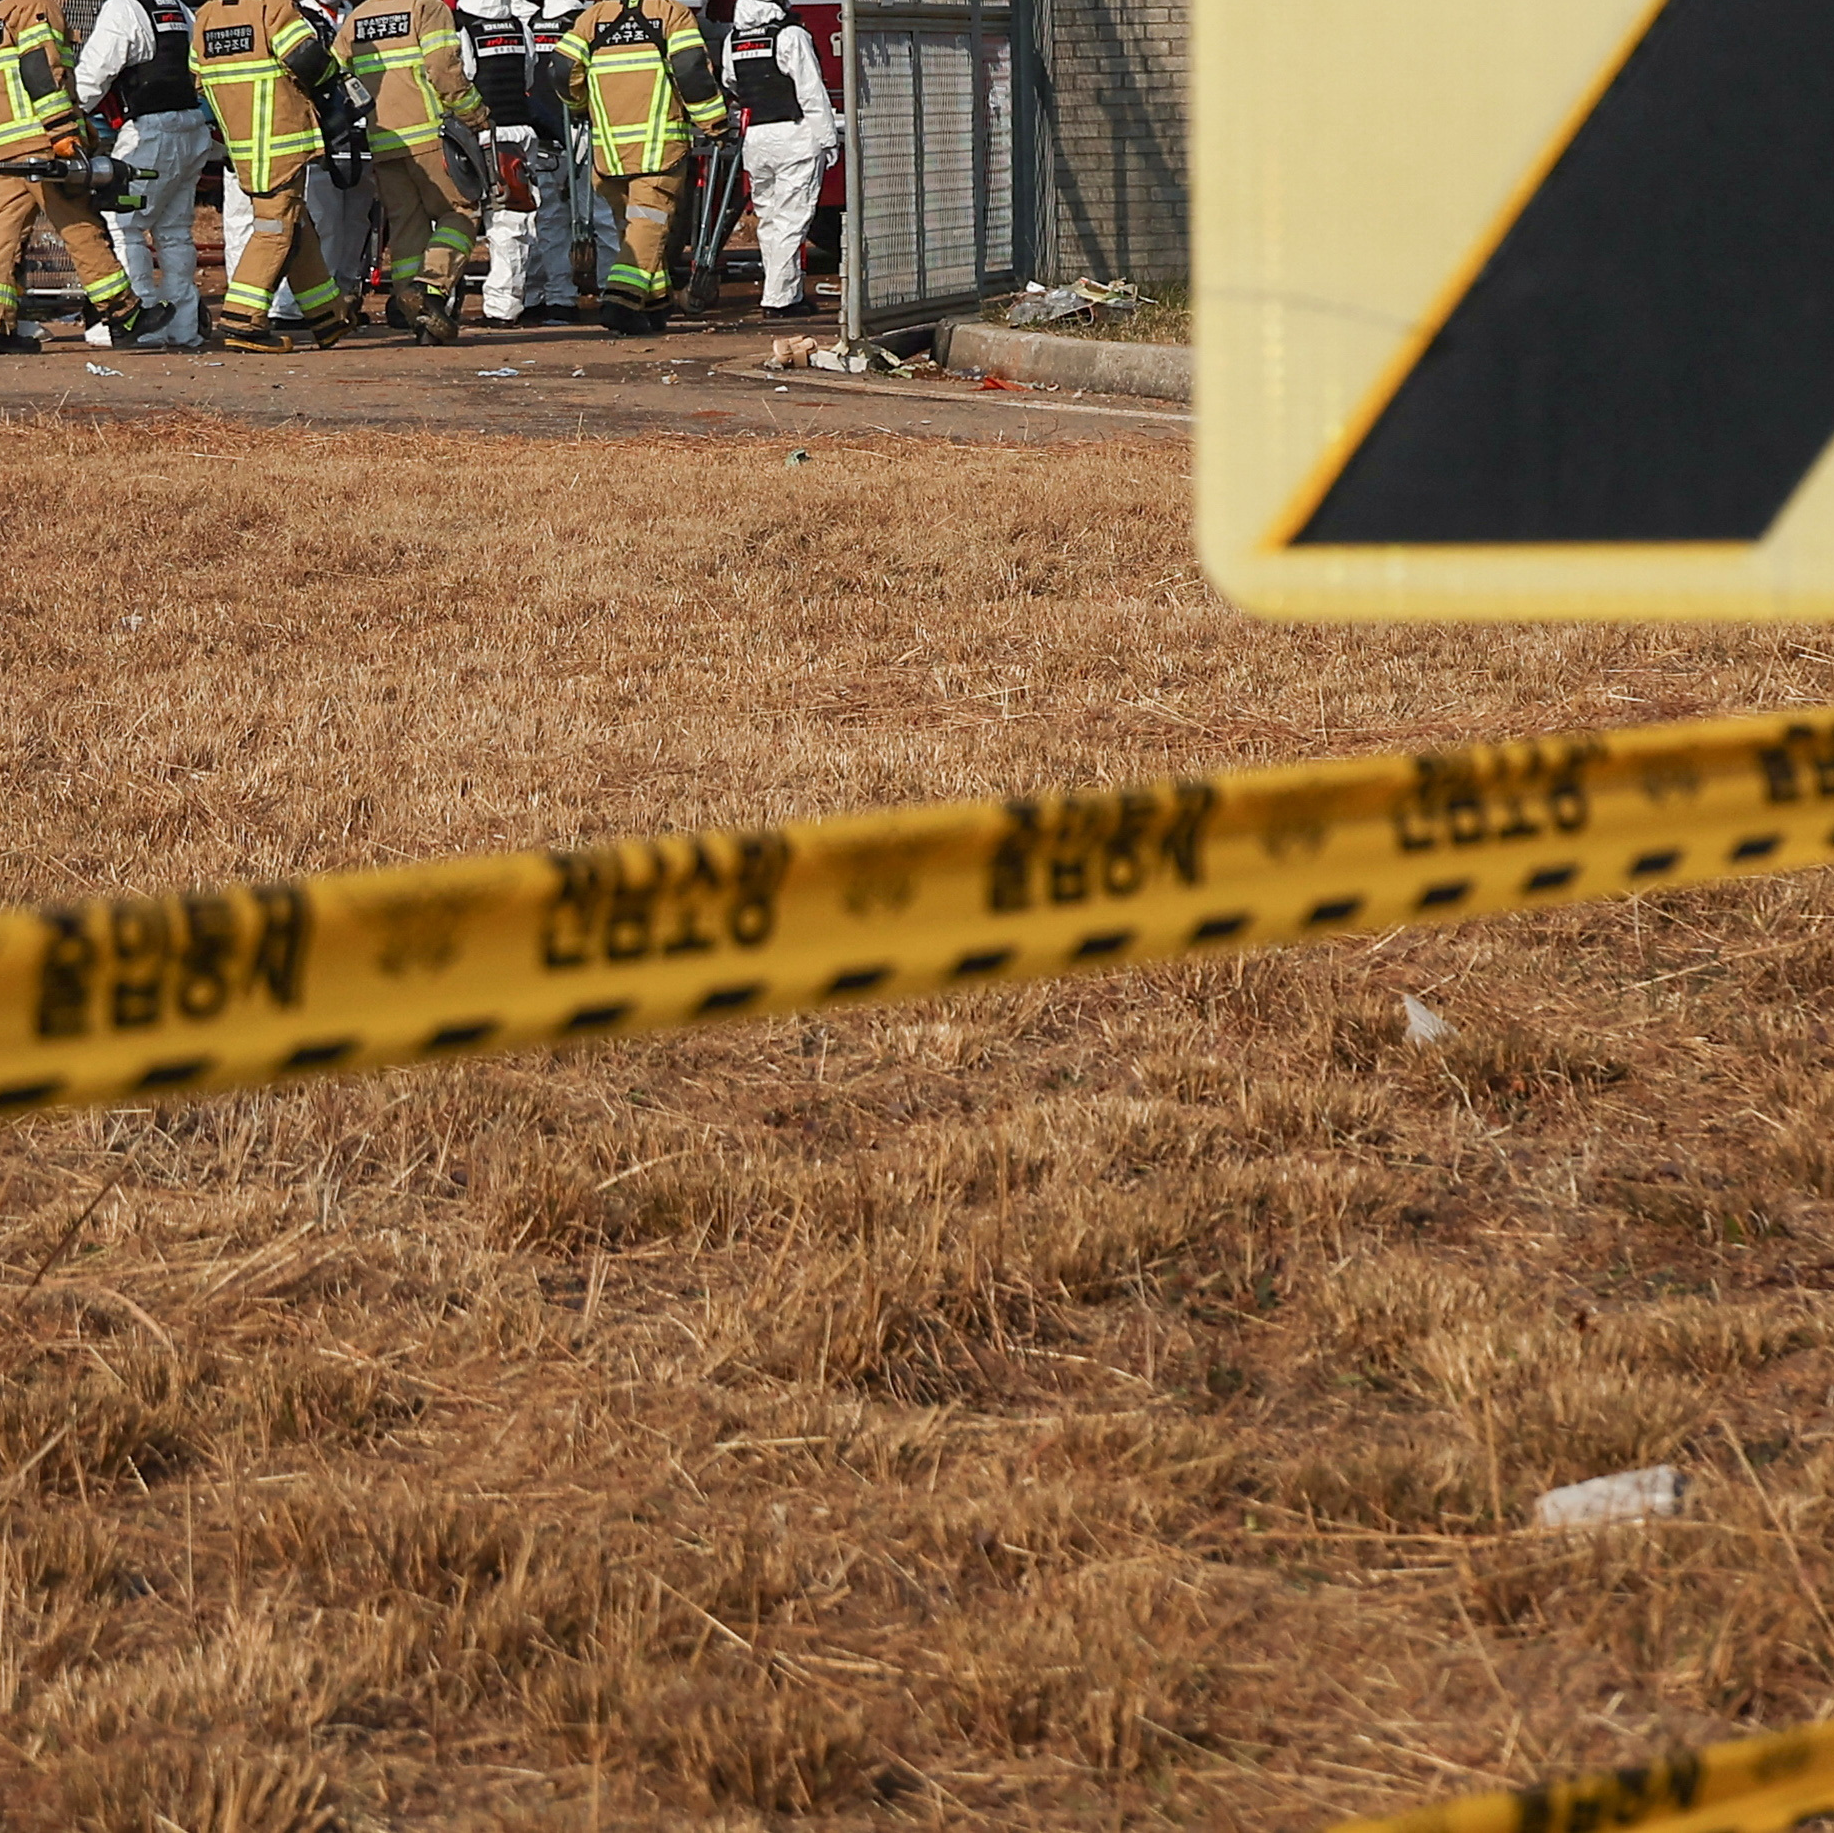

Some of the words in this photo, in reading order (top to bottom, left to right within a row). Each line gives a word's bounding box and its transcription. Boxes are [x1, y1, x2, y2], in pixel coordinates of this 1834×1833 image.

[606, 30, 649, 43] 수구조
[36, 886, 312, 1041] 출입통제
[542, 833, 790, 970] 전남소방
